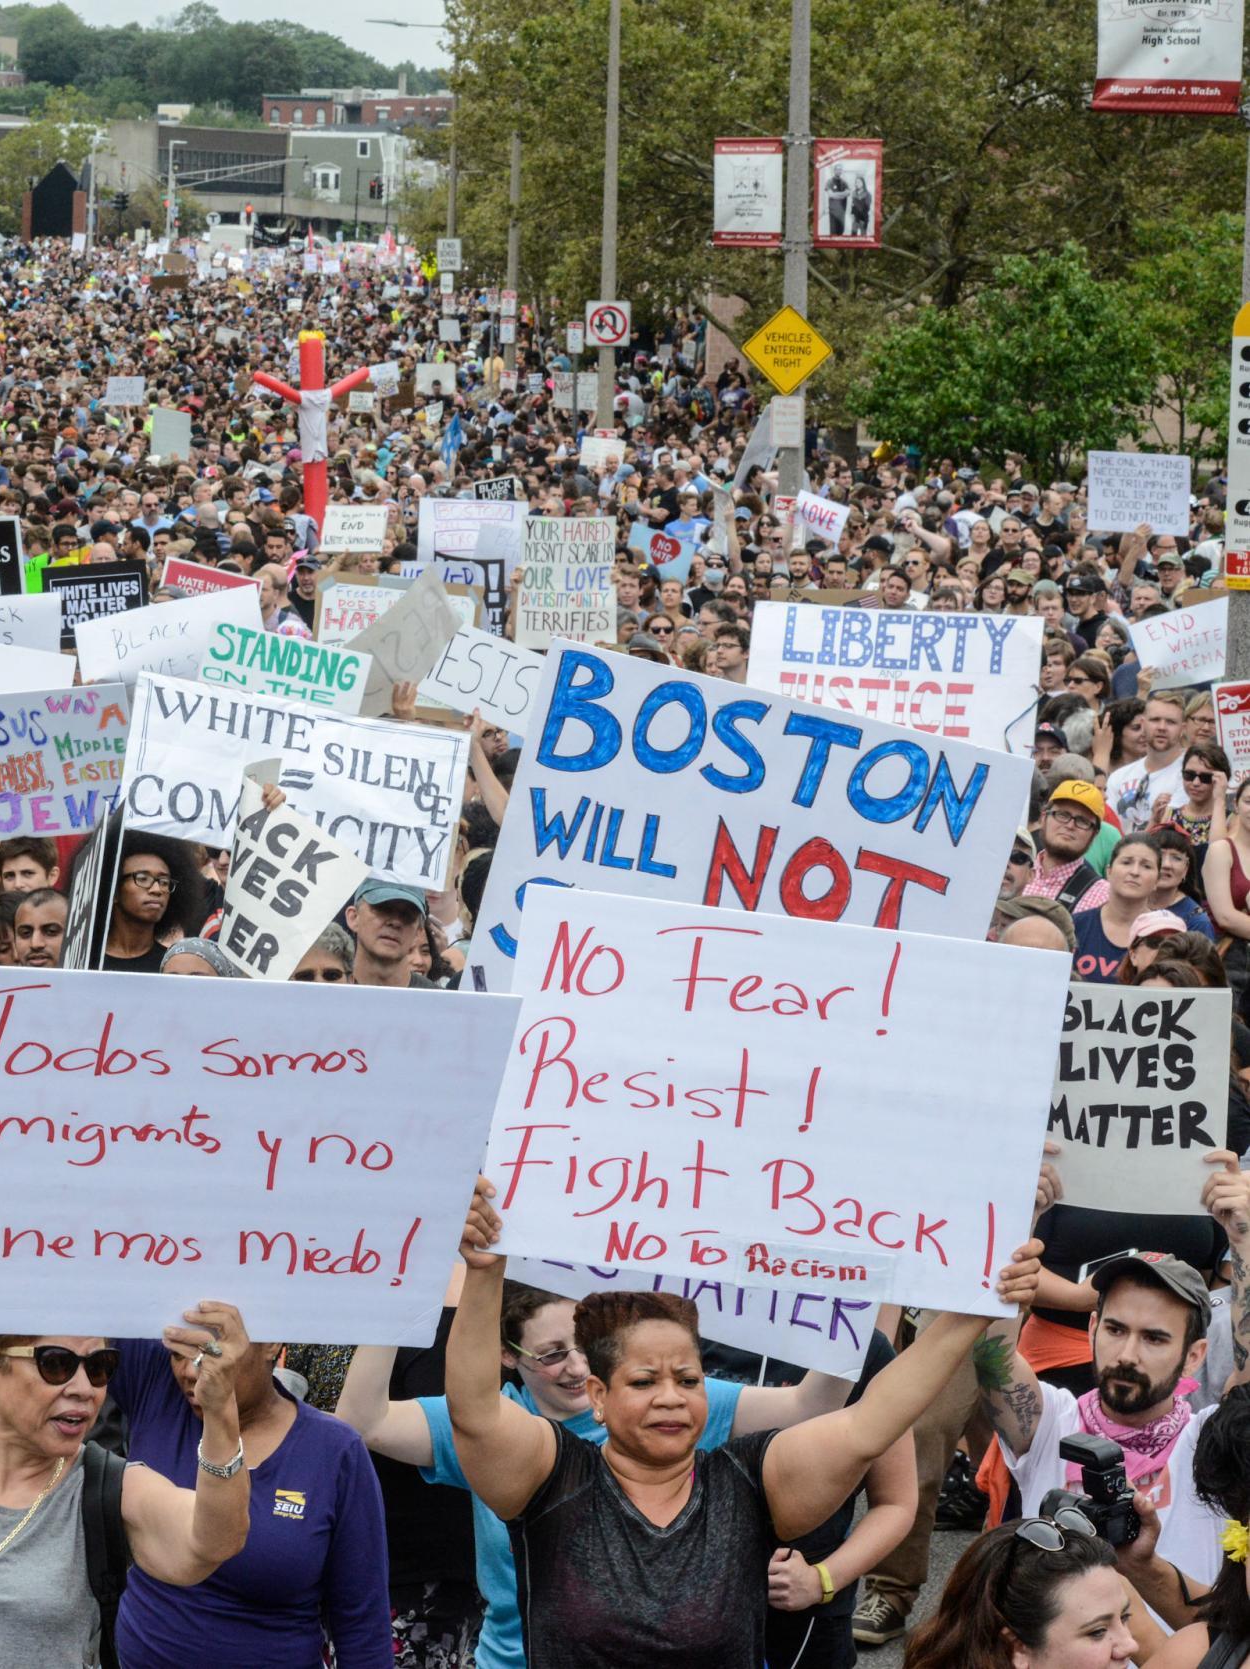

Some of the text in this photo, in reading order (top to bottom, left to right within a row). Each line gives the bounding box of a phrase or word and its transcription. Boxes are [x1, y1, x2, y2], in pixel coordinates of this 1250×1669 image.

[1142, 35, 1200, 47] High School
[1110, 85, 1141, 95] Mayor
[1143, 86, 1175, 95] Martin
[1191, 87, 1221, 96] Walsh
[766, 332, 812, 343] VEHICLES
[764, 345, 812, 355] ENTERING
[773, 358, 801, 368] RIGHT
[1093, 467, 1183, 479] NECESSARY FOR
[1117, 458, 1184, 469] ONLY THING
[479, 480, 511, 493] BLACK
[1095, 477, 1114, 487] THE
[1171, 482, 1185, 490] OF
[1102, 489, 1171, 500] EVIL IS FOR
[801, 501, 838, 531] LOVE
[1094, 509, 1125, 521] TO DO
[1112, 500, 1167, 511] GOOD MEN
[341, 521, 364, 530] END
[525, 519, 610, 541] YOUR HATRED
[568, 543, 601, 564] SCARE
[657, 538, 672, 552] NO
[52, 584, 97, 598] WHITE
[105, 580, 140, 596] LIVES
[177, 575, 204, 590] HATE
[523, 566, 610, 591] OUR LOVE
[66, 597, 128, 615] MATTER
[338, 599, 377, 611] DOES
[522, 611, 609, 631] TERRIFIES
[1145, 614, 1196, 641] END
[112, 621, 190, 660] BLACK
[781, 605, 1017, 675] LIBERTY
[1167, 628, 1223, 654] WHITE
[209, 623, 360, 692] STANDING
[878, 669, 902, 680] AND
[203, 666, 336, 706] ON THE
[98, 702, 128, 731] A
[152, 686, 317, 754] WHITE
[52, 732, 125, 762] MIDDLE
[534, 647, 991, 848] BOSTON
[322, 741, 454, 829] SILENCE
[528, 785, 679, 880] WILL
[701, 814, 952, 931] NOT
[1062, 991, 1197, 1042] BLACK
[1059, 1042, 1197, 1092] LIVES
[1047, 1094, 1217, 1149] MATTER
[308, 1132, 396, 1172] no
[499, 1124, 732, 1219] Fight
[744, 1242, 869, 1282] Racism
[273, 1502, 304, 1514] SEIU
